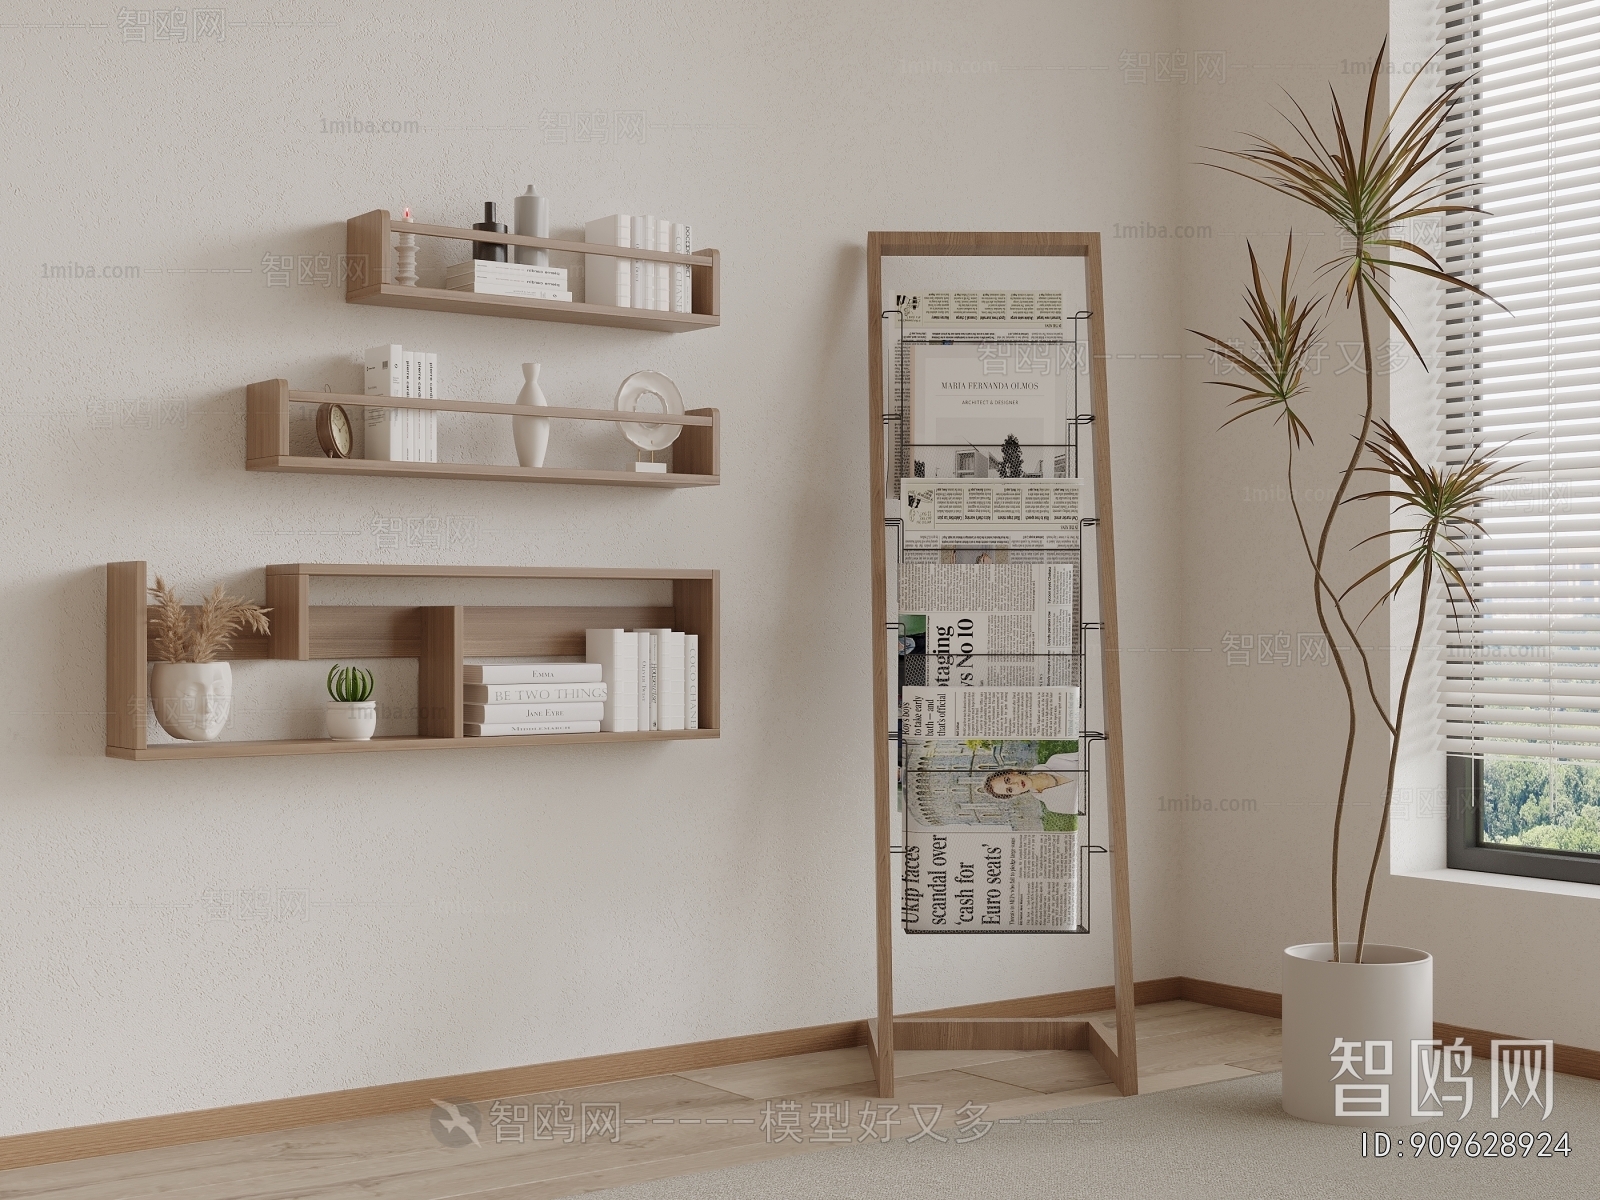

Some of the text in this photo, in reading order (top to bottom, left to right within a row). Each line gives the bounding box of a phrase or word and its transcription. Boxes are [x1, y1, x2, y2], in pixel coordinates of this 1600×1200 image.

[957, 619, 974, 638] 10
[933, 626, 954, 686] taging
[956, 642, 974, 668] No
[495, 687, 608, 701] BE TWO THINGS
[925, 699, 934, 712] and
[937, 693, 946, 717] official
[912, 695, 923, 736] to take early
[925, 721, 934, 737] bath
[901, 845, 924, 924] Ukip faces
[927, 834, 947, 925] scandal over
[954, 862, 974, 884] for
[982, 888, 1001, 925] Euro
